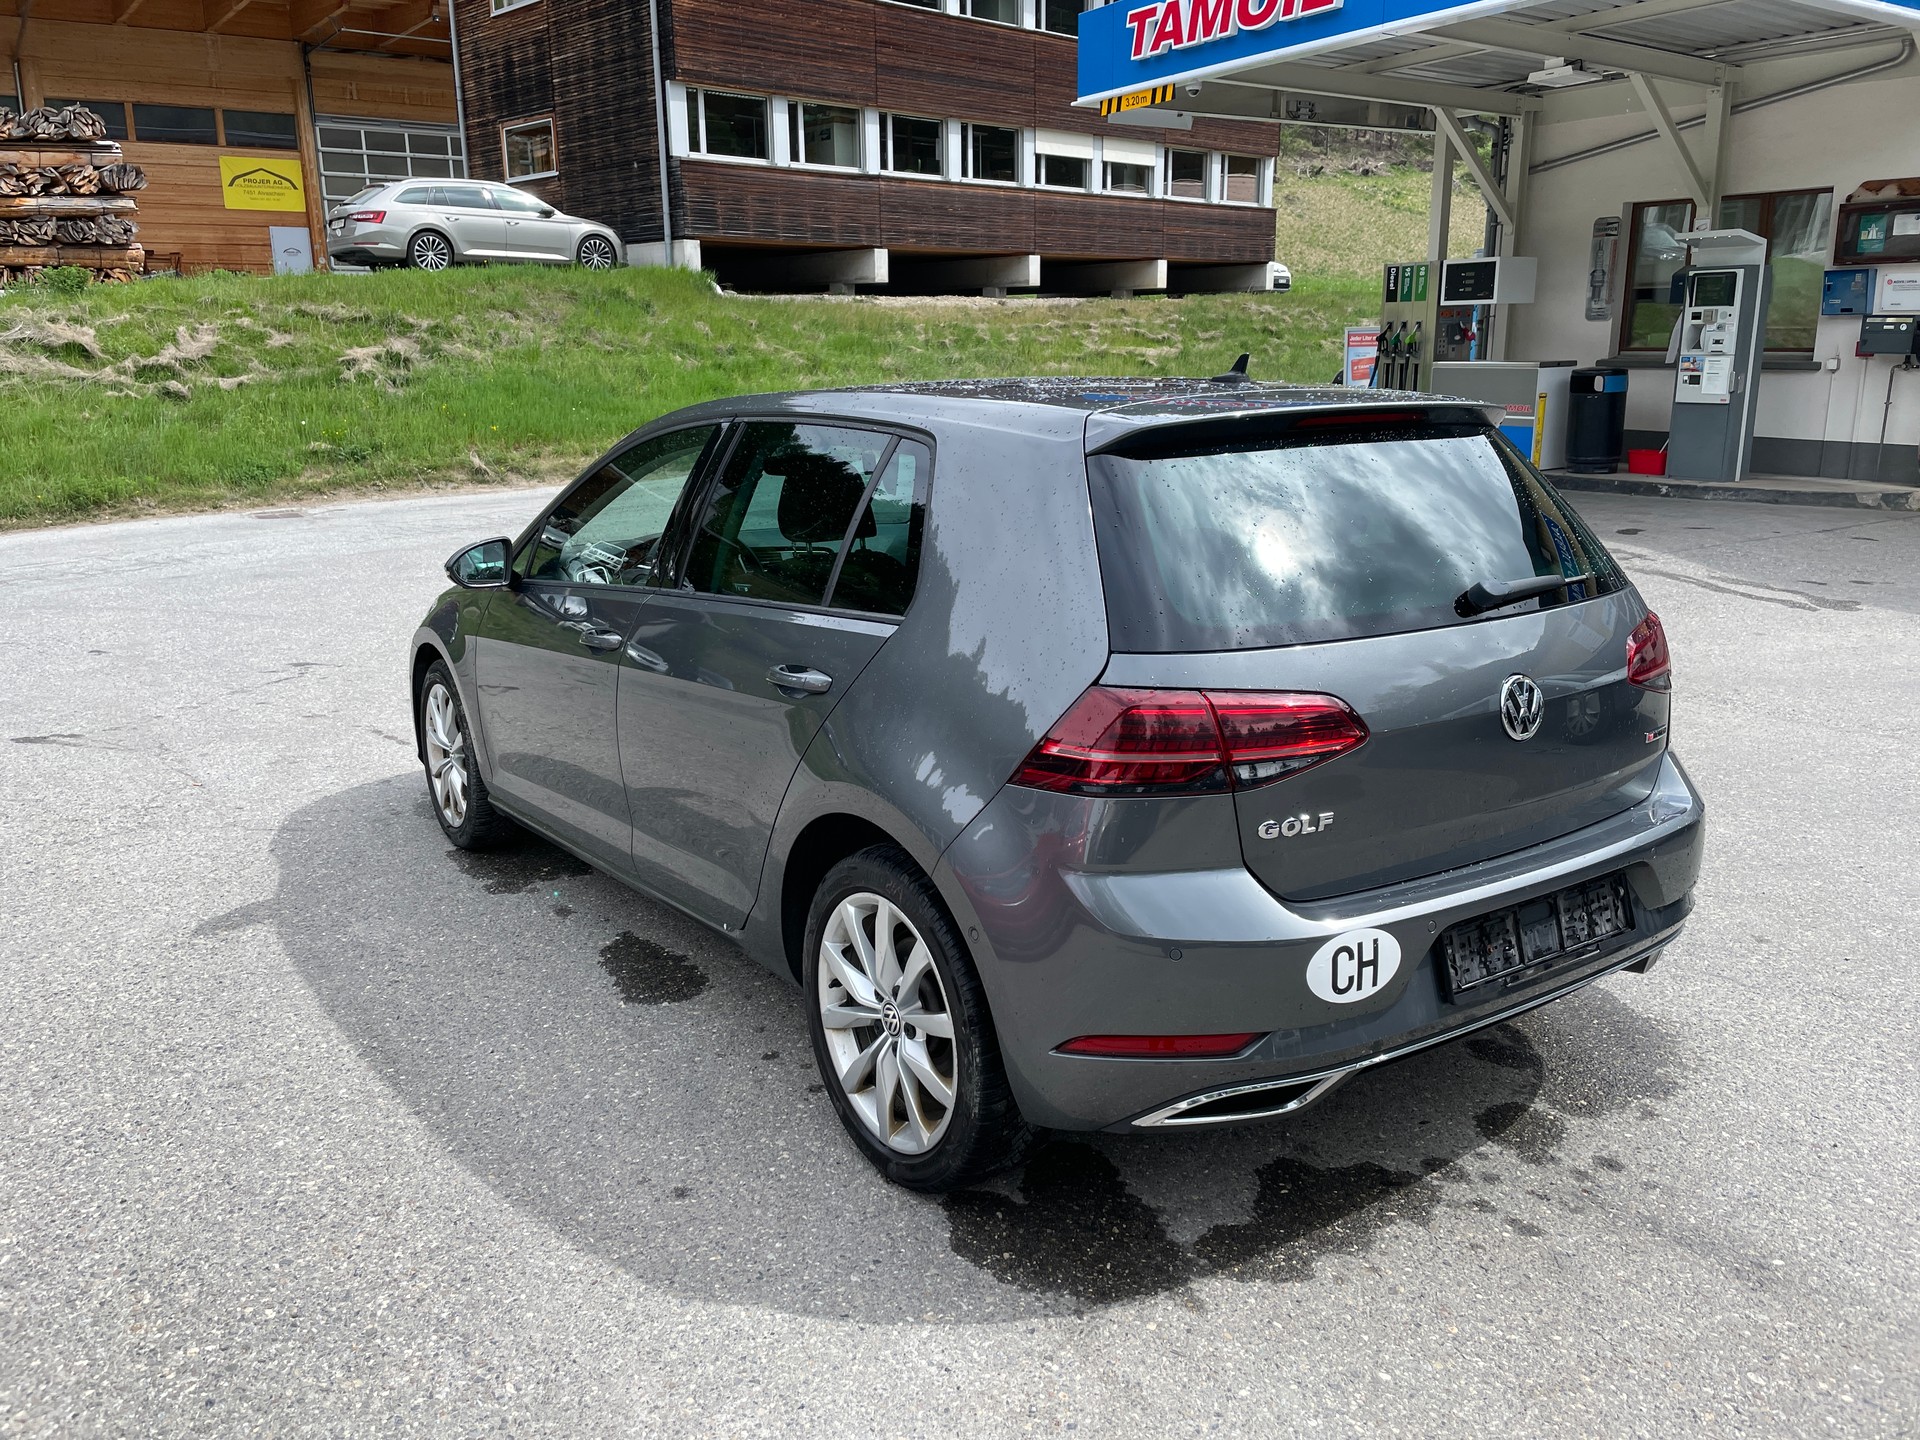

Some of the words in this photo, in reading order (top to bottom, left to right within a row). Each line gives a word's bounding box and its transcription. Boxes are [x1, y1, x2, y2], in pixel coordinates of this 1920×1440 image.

[1126, 0, 1342, 60] TAMO
[1389, 267, 1397, 290] Diesel
[1404, 267, 1411, 277] 95
[1419, 266, 1426, 276] 98
[1257, 811, 1335, 840] GOLF
[1331, 937, 1379, 996] CH
